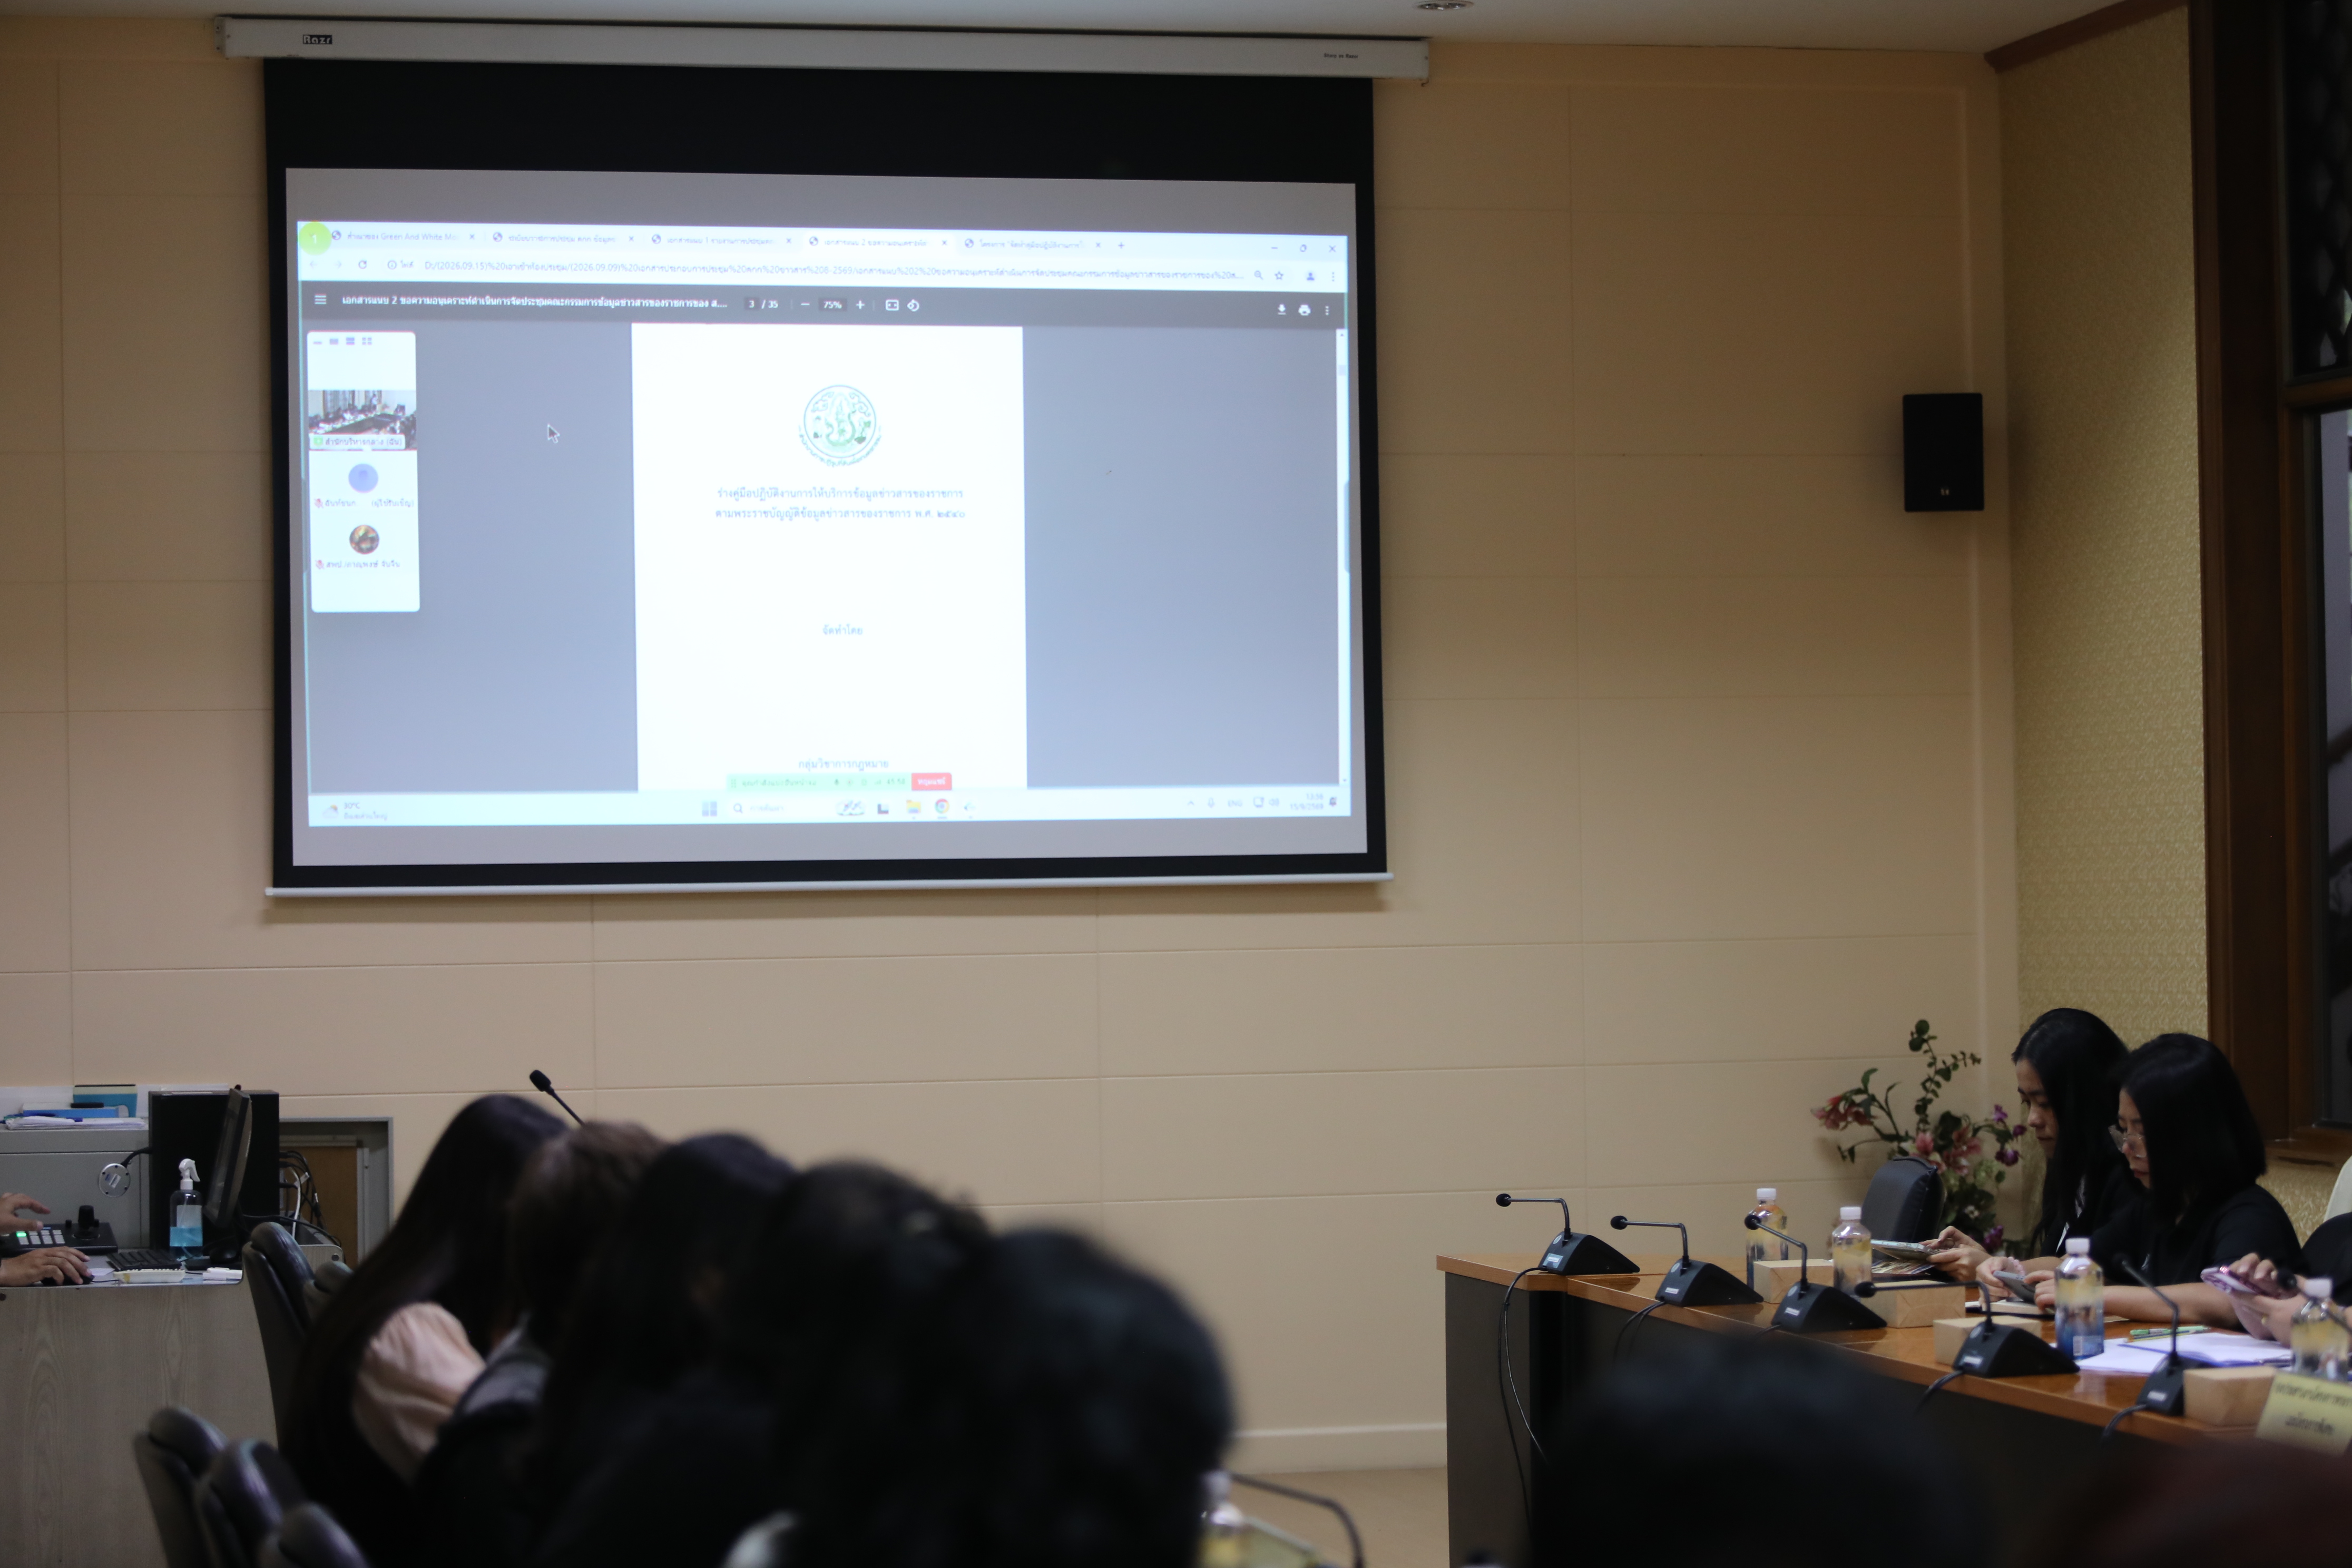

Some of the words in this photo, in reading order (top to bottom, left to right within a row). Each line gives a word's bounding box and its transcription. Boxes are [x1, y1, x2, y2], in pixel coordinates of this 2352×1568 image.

[303, 35, 331, 44] Razr
[342, 296, 389, 305] เอกสารแนบ
[391, 296, 397, 305] 2
[748, 300, 755, 308] 3
[767, 300, 779, 308] 35
[718, 486, 964, 502] ร่างคู่มือปฏิบัติงานการให้บริการข้อมูลข่าวสารของราชการ
[715, 505, 912, 522] ตามพระราชบัญญัติข้อมูลข่าวสารของราชการ
[915, 509, 934, 519] พ.ศ.
[822, 622, 864, 635] จัดทำโดย
[798, 757, 889, 772] กลุ่มวิชาการกฎหมาย
